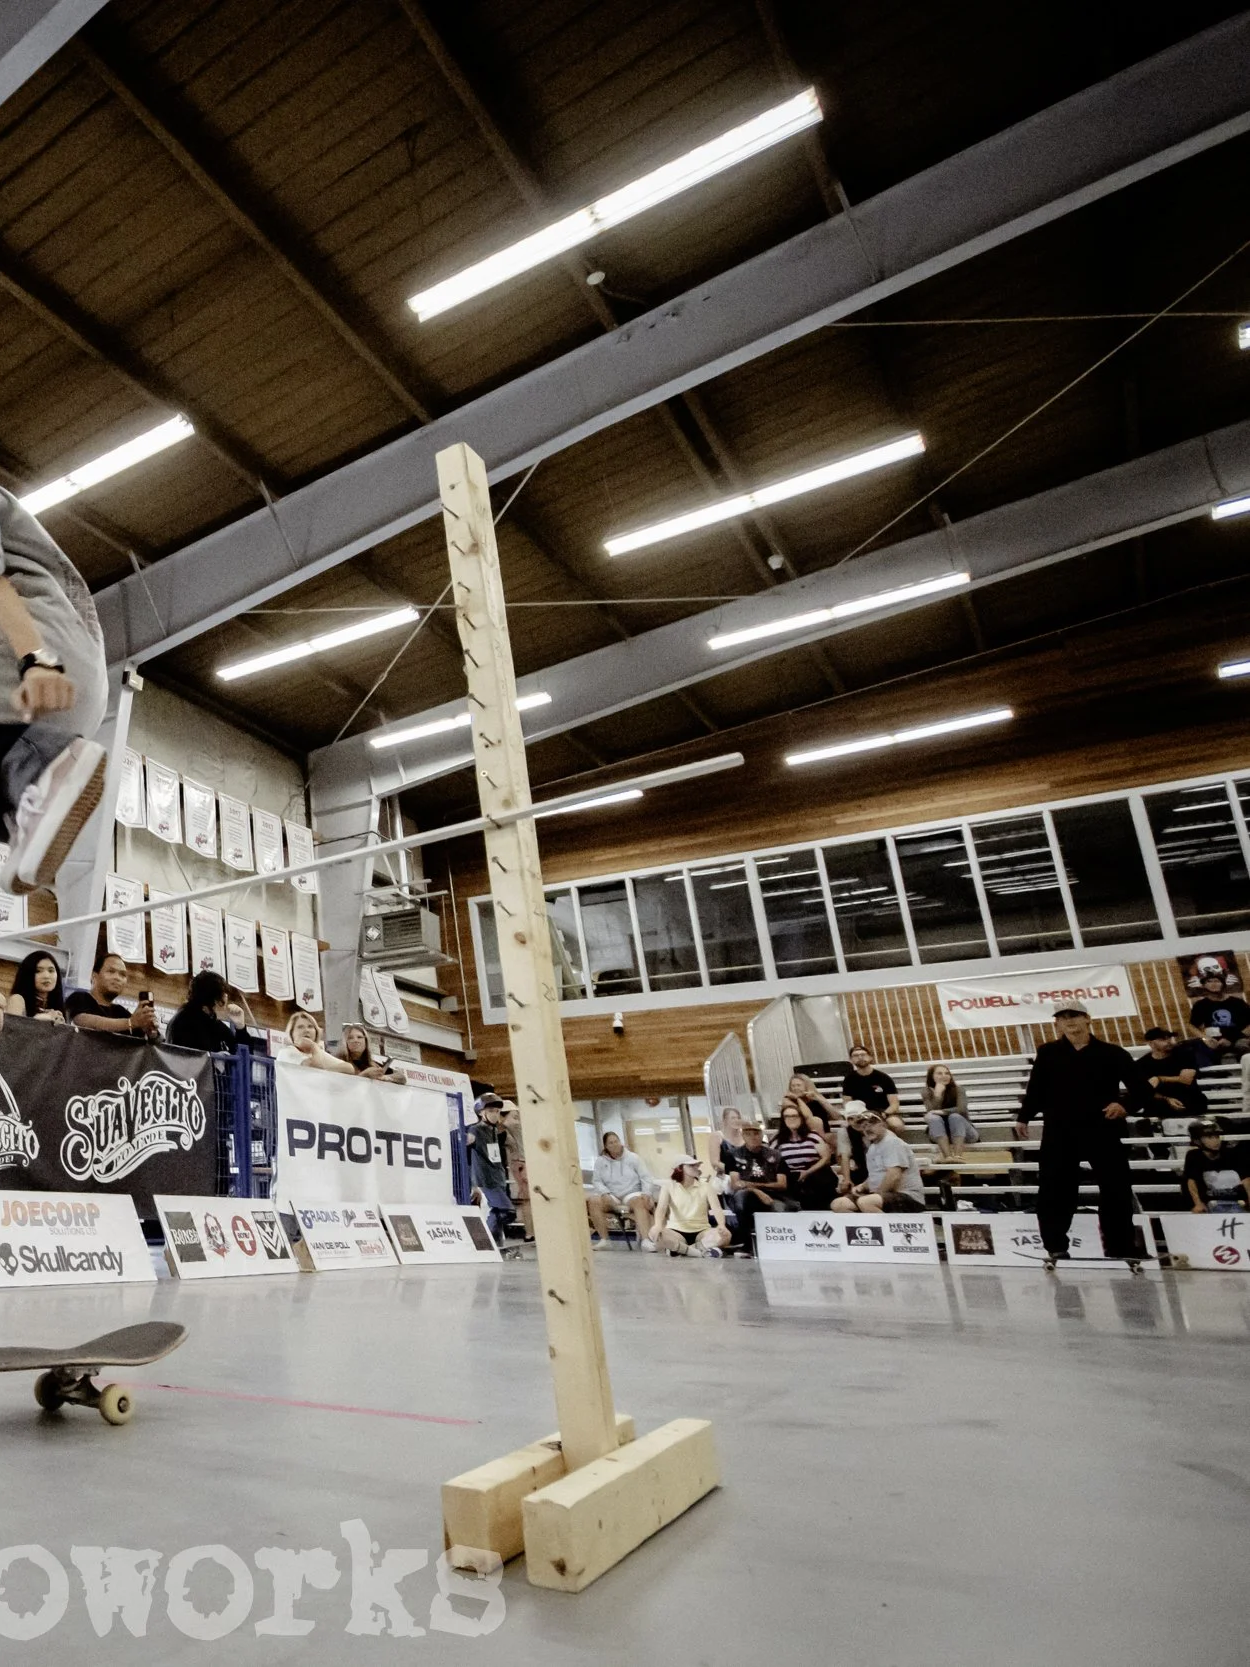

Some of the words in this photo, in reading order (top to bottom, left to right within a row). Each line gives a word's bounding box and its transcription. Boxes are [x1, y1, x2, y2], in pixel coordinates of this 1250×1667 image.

[947, 994, 1021, 1012] POWELL
[1037, 984, 1121, 1004] PERALTA
[60, 1071, 207, 1182] SUAVECITO
[0, 1199, 101, 1226] JOECORP
[765, 1225, 794, 1235] Skate
[888, 1221, 925, 1230] HENRY
[426, 1227, 463, 1242] TASHME
[765, 1233, 797, 1242] board
[1011, 1233, 1082, 1249] TASE
[18, 1244, 124, 1277] Skullcandy
